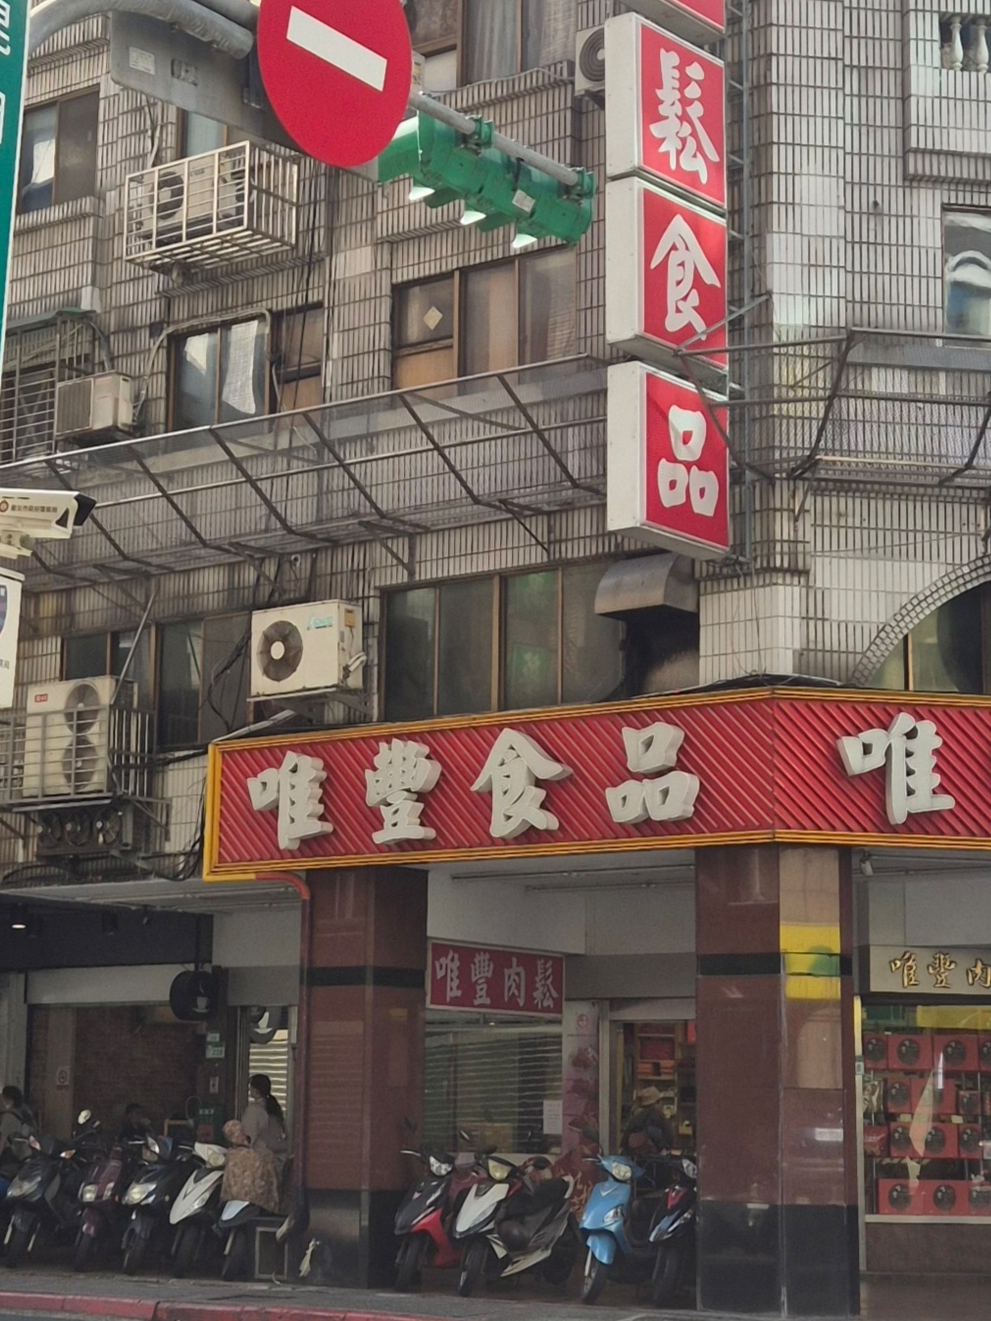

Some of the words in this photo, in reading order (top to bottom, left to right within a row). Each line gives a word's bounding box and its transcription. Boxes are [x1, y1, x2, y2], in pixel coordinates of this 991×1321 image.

[649, 47, 721, 517] 鬆食品
[247, 722, 700, 850] 唯豐食品
[837, 712, 955, 825] 唯
[435, 949, 558, 1009] 唯豐肉鬆
[889, 950, 991, 989] 唯豐肉
